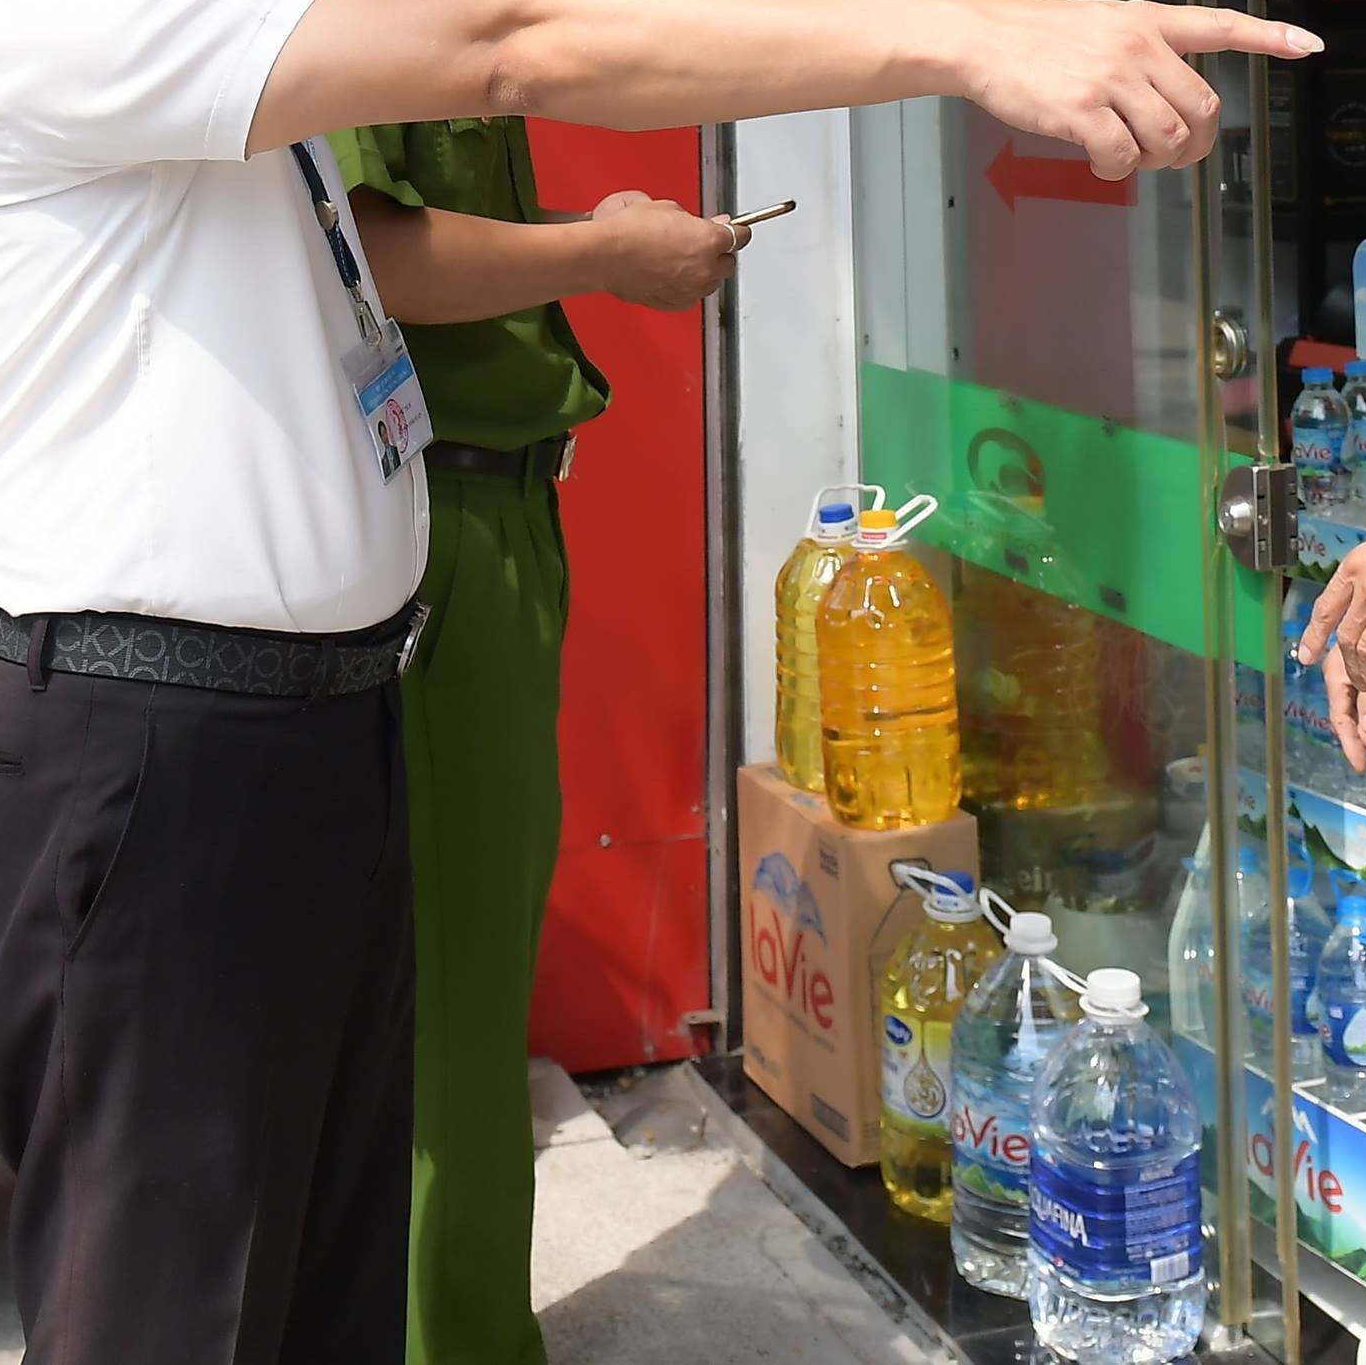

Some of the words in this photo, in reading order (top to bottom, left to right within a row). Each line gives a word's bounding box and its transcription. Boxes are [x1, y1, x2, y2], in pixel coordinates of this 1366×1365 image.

[1293, 442, 1332, 461] aVie
[1296, 532, 1326, 557] aVie
[951, 1105, 1031, 1163] aVie
